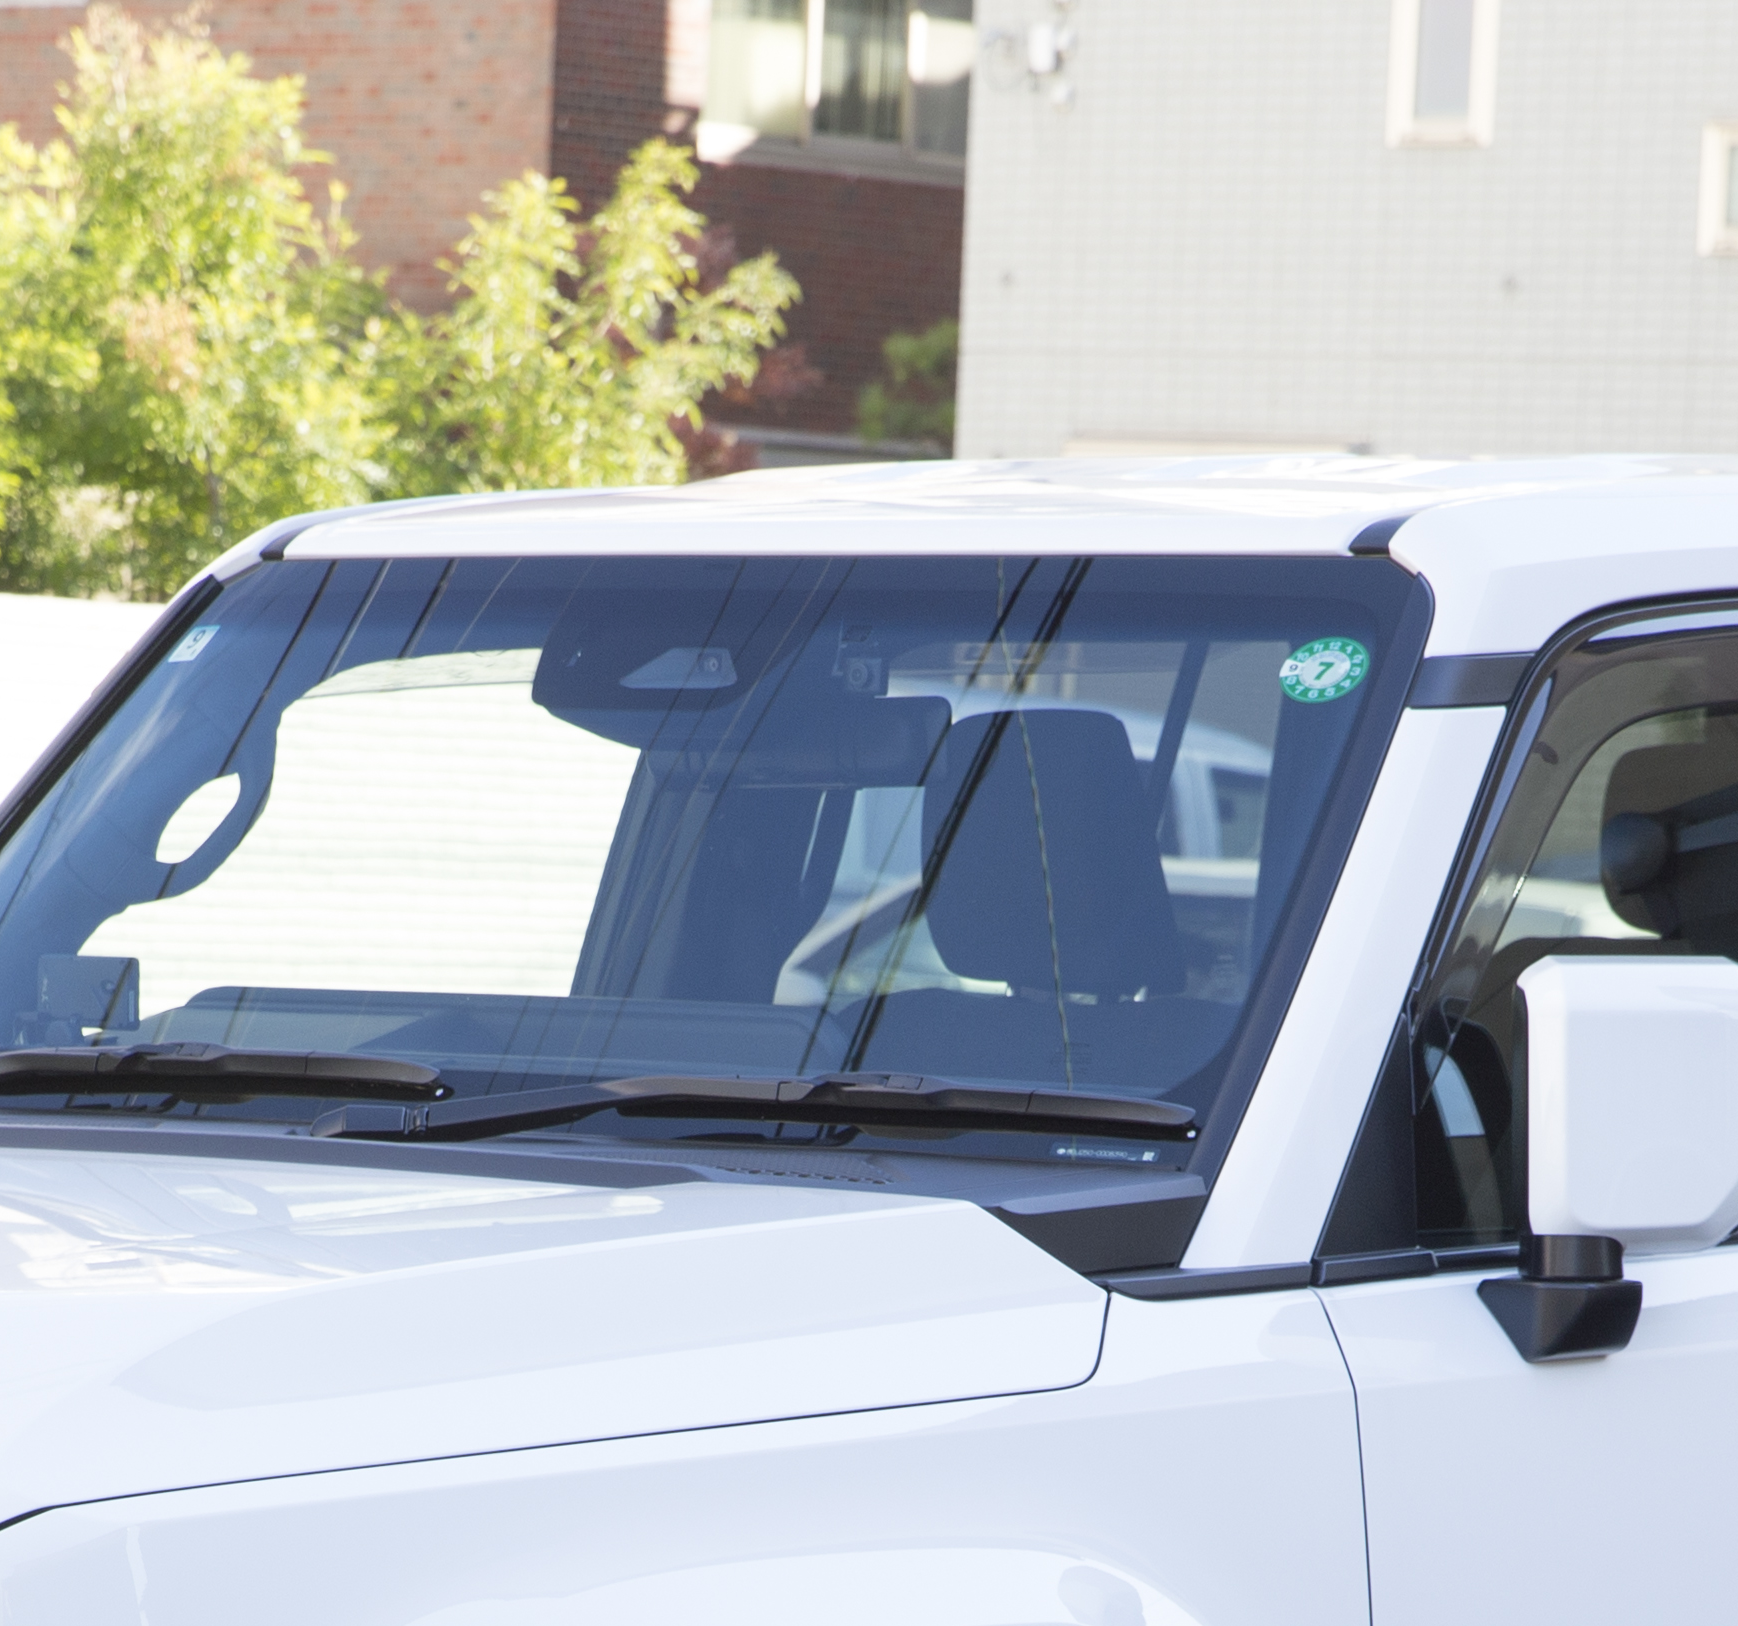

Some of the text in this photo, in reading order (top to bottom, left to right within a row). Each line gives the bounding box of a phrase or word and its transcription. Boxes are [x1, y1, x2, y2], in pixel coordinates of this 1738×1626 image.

[1329, 641, 1342, 650] 12
[1314, 662, 1335, 681] 7
[1350, 667, 1361, 676] 3
[1339, 679, 1352, 688] 4
